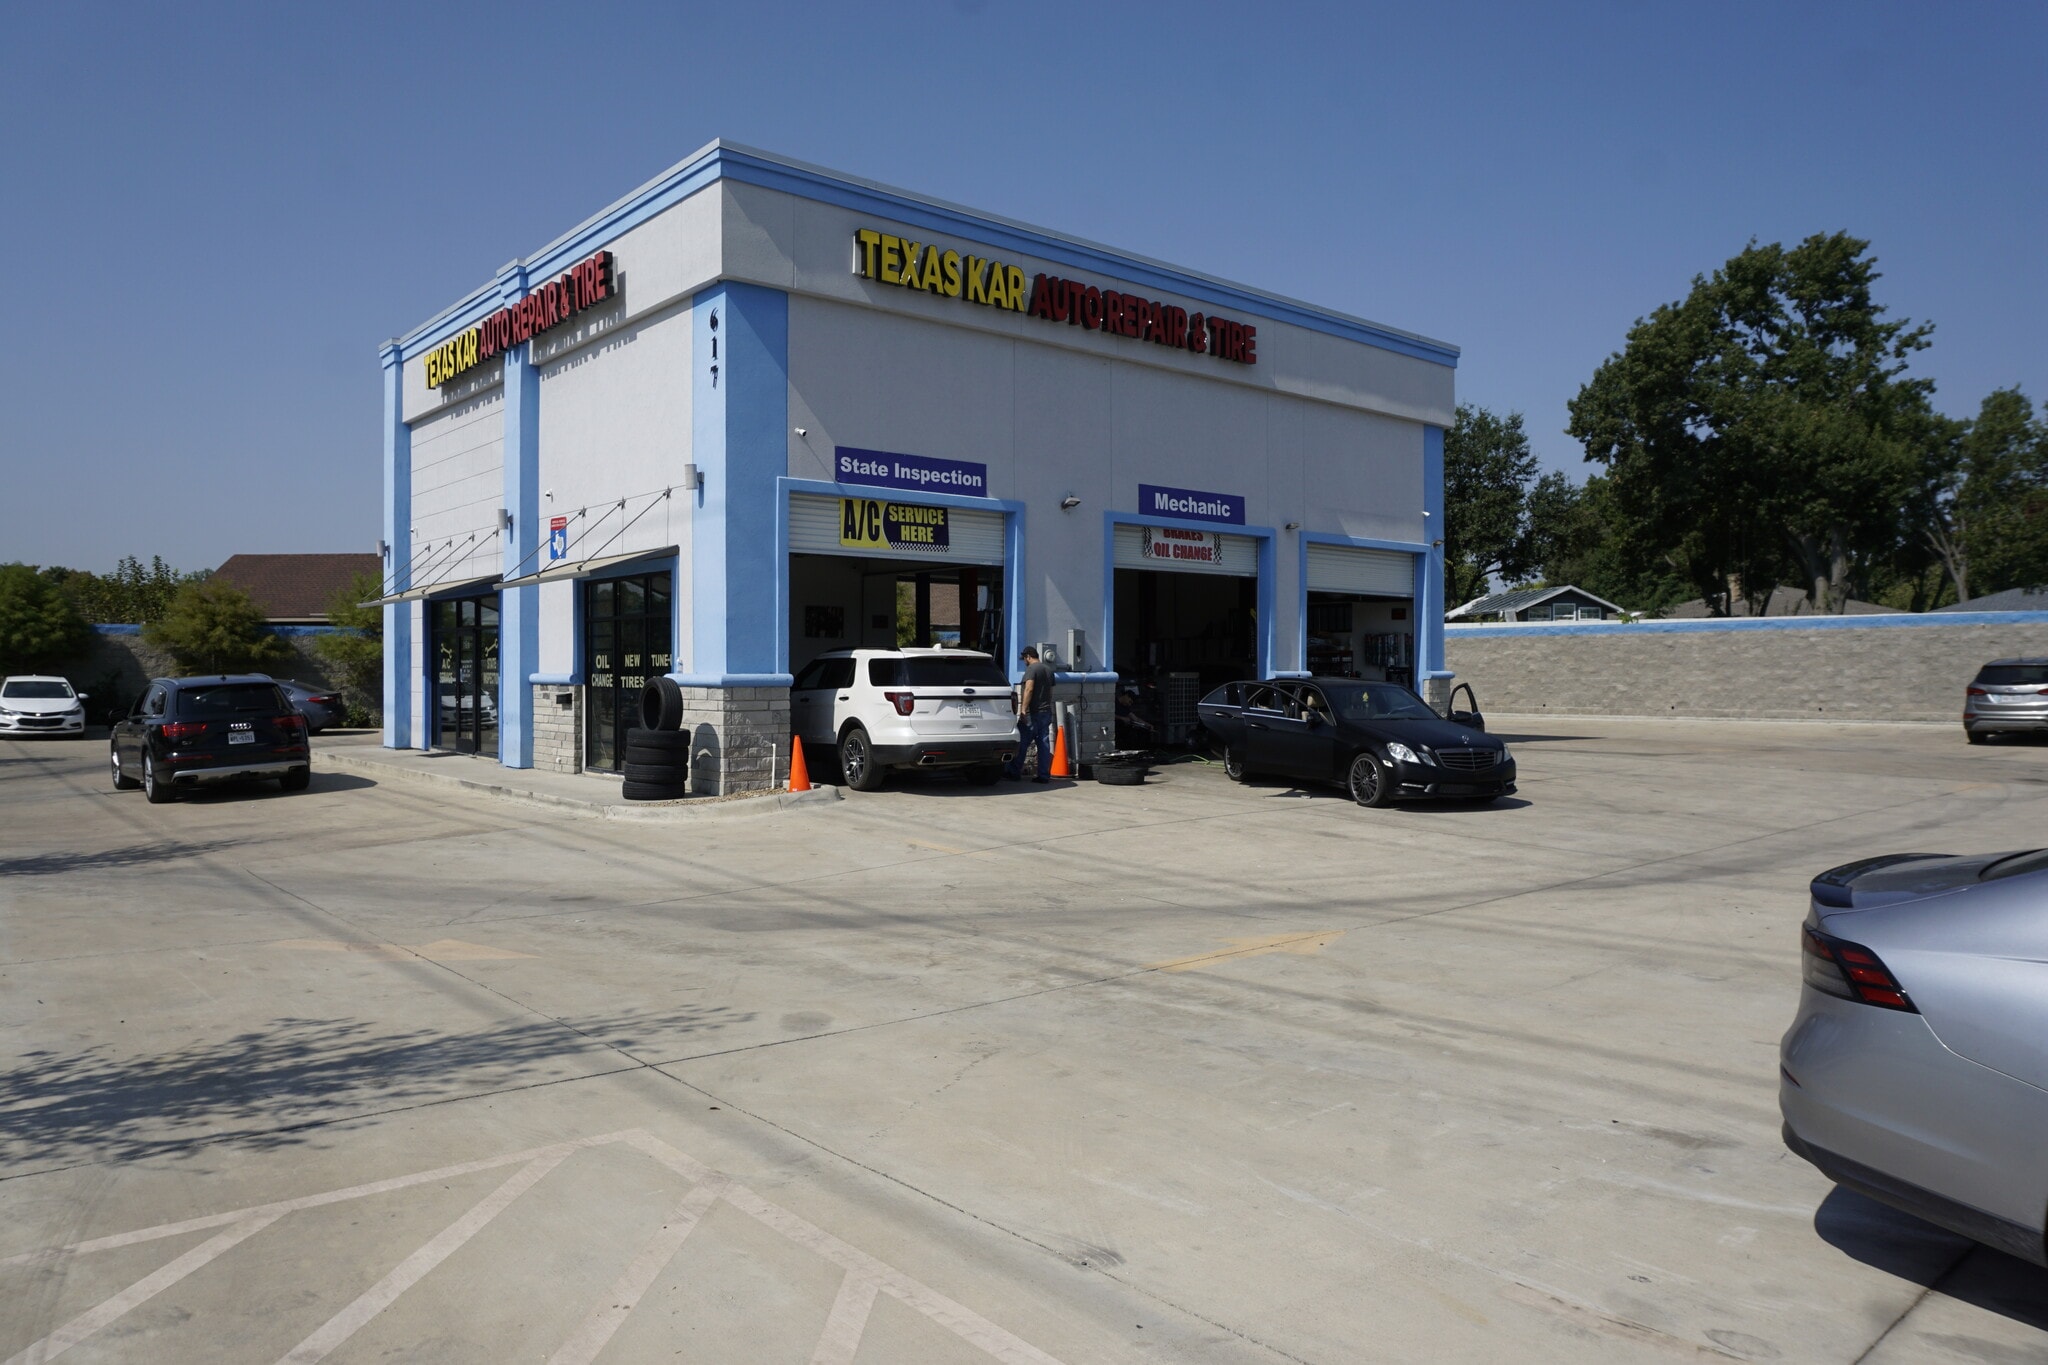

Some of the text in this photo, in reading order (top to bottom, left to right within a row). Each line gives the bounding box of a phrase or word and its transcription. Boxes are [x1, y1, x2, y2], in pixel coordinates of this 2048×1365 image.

[857, 229, 1257, 364] TEXAS KAR AUTO REPAIR & TIRE
[424, 251, 608, 389] TEXAS KAR AUTO REPAIR & TIRE
[709, 307, 719, 390] 617
[840, 456, 982, 488] State Inspection
[1154, 492, 1231, 517] Mechanic
[843, 499, 880, 542] A/C
[888, 505, 945, 526] SERVICE
[900, 525, 934, 543] HERE
[1153, 542, 1213, 561] OIL CHANGE
[595, 654, 610, 669] OIL
[624, 654, 641, 667] NEW
[591, 673, 613, 687] CHANGE
[620, 676, 645, 689] TIRES
